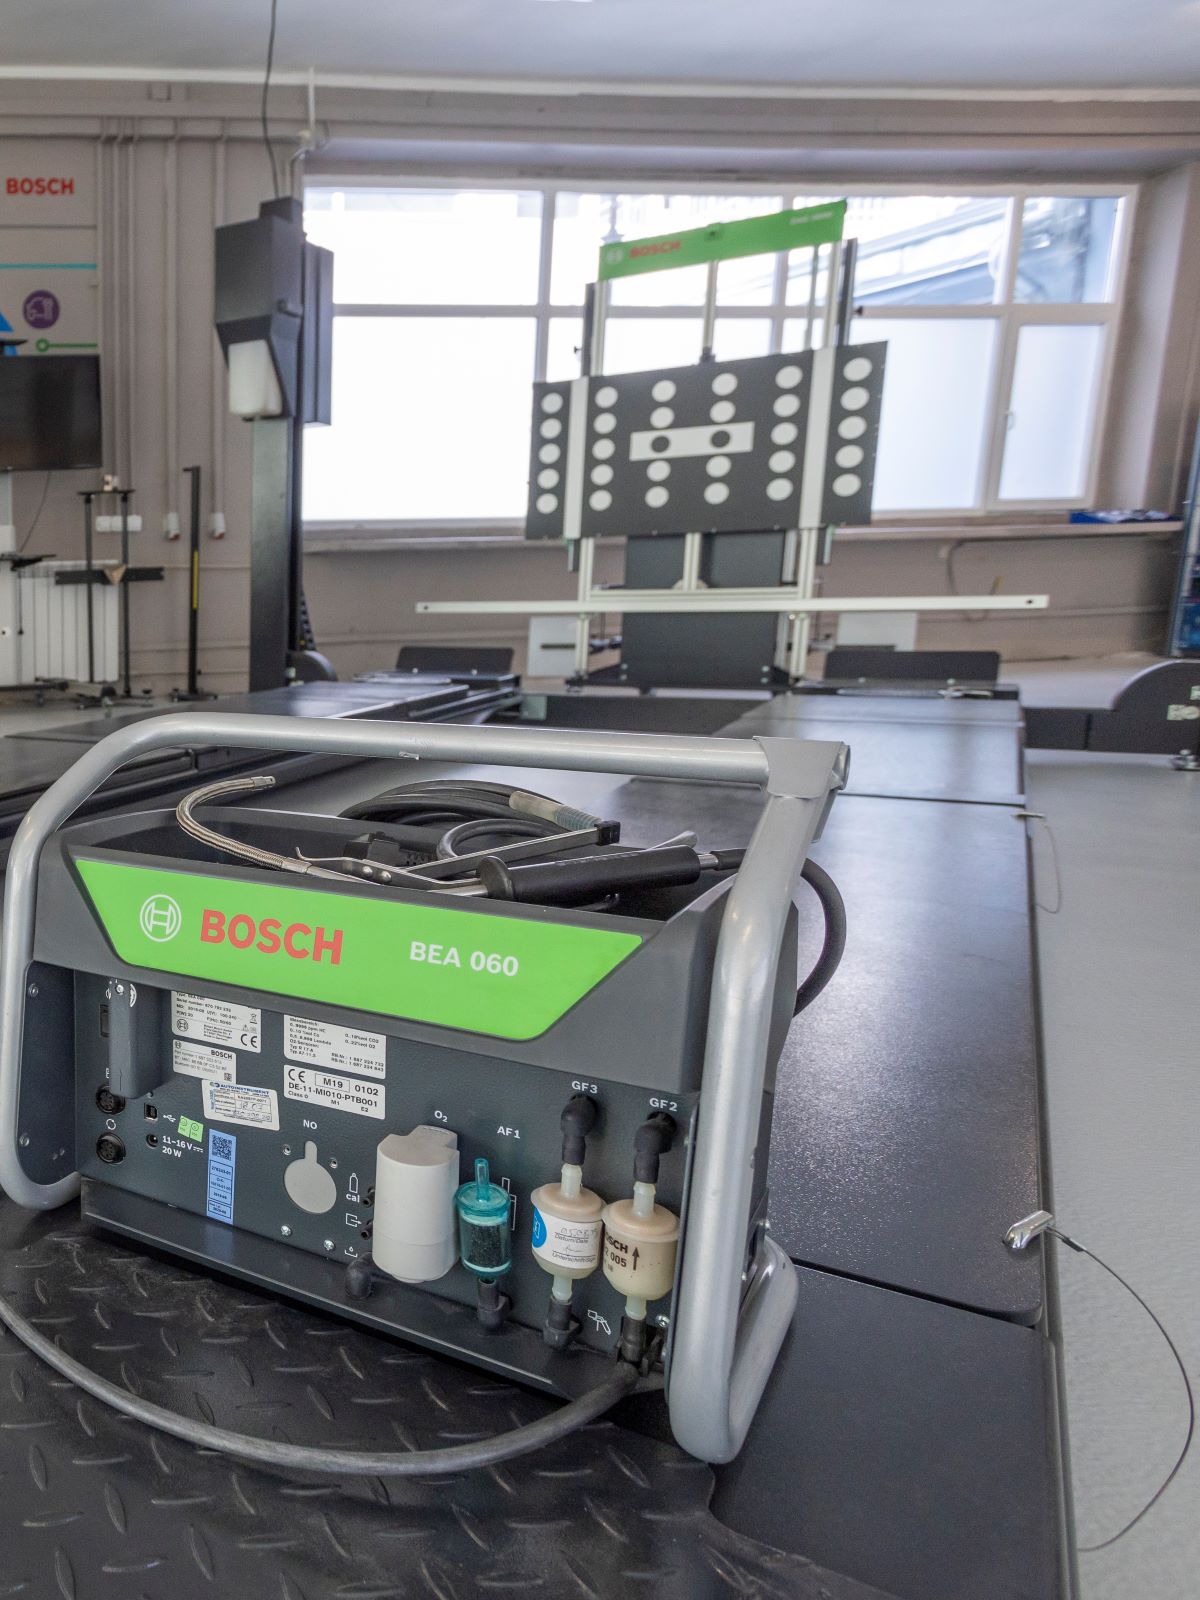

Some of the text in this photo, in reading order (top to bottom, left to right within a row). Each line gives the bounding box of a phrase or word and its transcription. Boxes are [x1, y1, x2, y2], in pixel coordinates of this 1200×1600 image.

[6, 177, 75, 195] BOSCH
[629, 241, 681, 259] BOSCH
[200, 908, 519, 977] BOSCH BEA 060
[211, 1050, 233, 1060] BOSCH
[288, 1082, 378, 1107] DE-11-MI010-PTB001
[323, 1077, 343, 1089] M19
[354, 1084, 379, 1096] 0102
[303, 1119, 318, 1130] NO
[162, 1145, 182, 1157] 20 W
[345, 1192, 360, 1203] cal
[610, 1251, 627, 1268] 005
